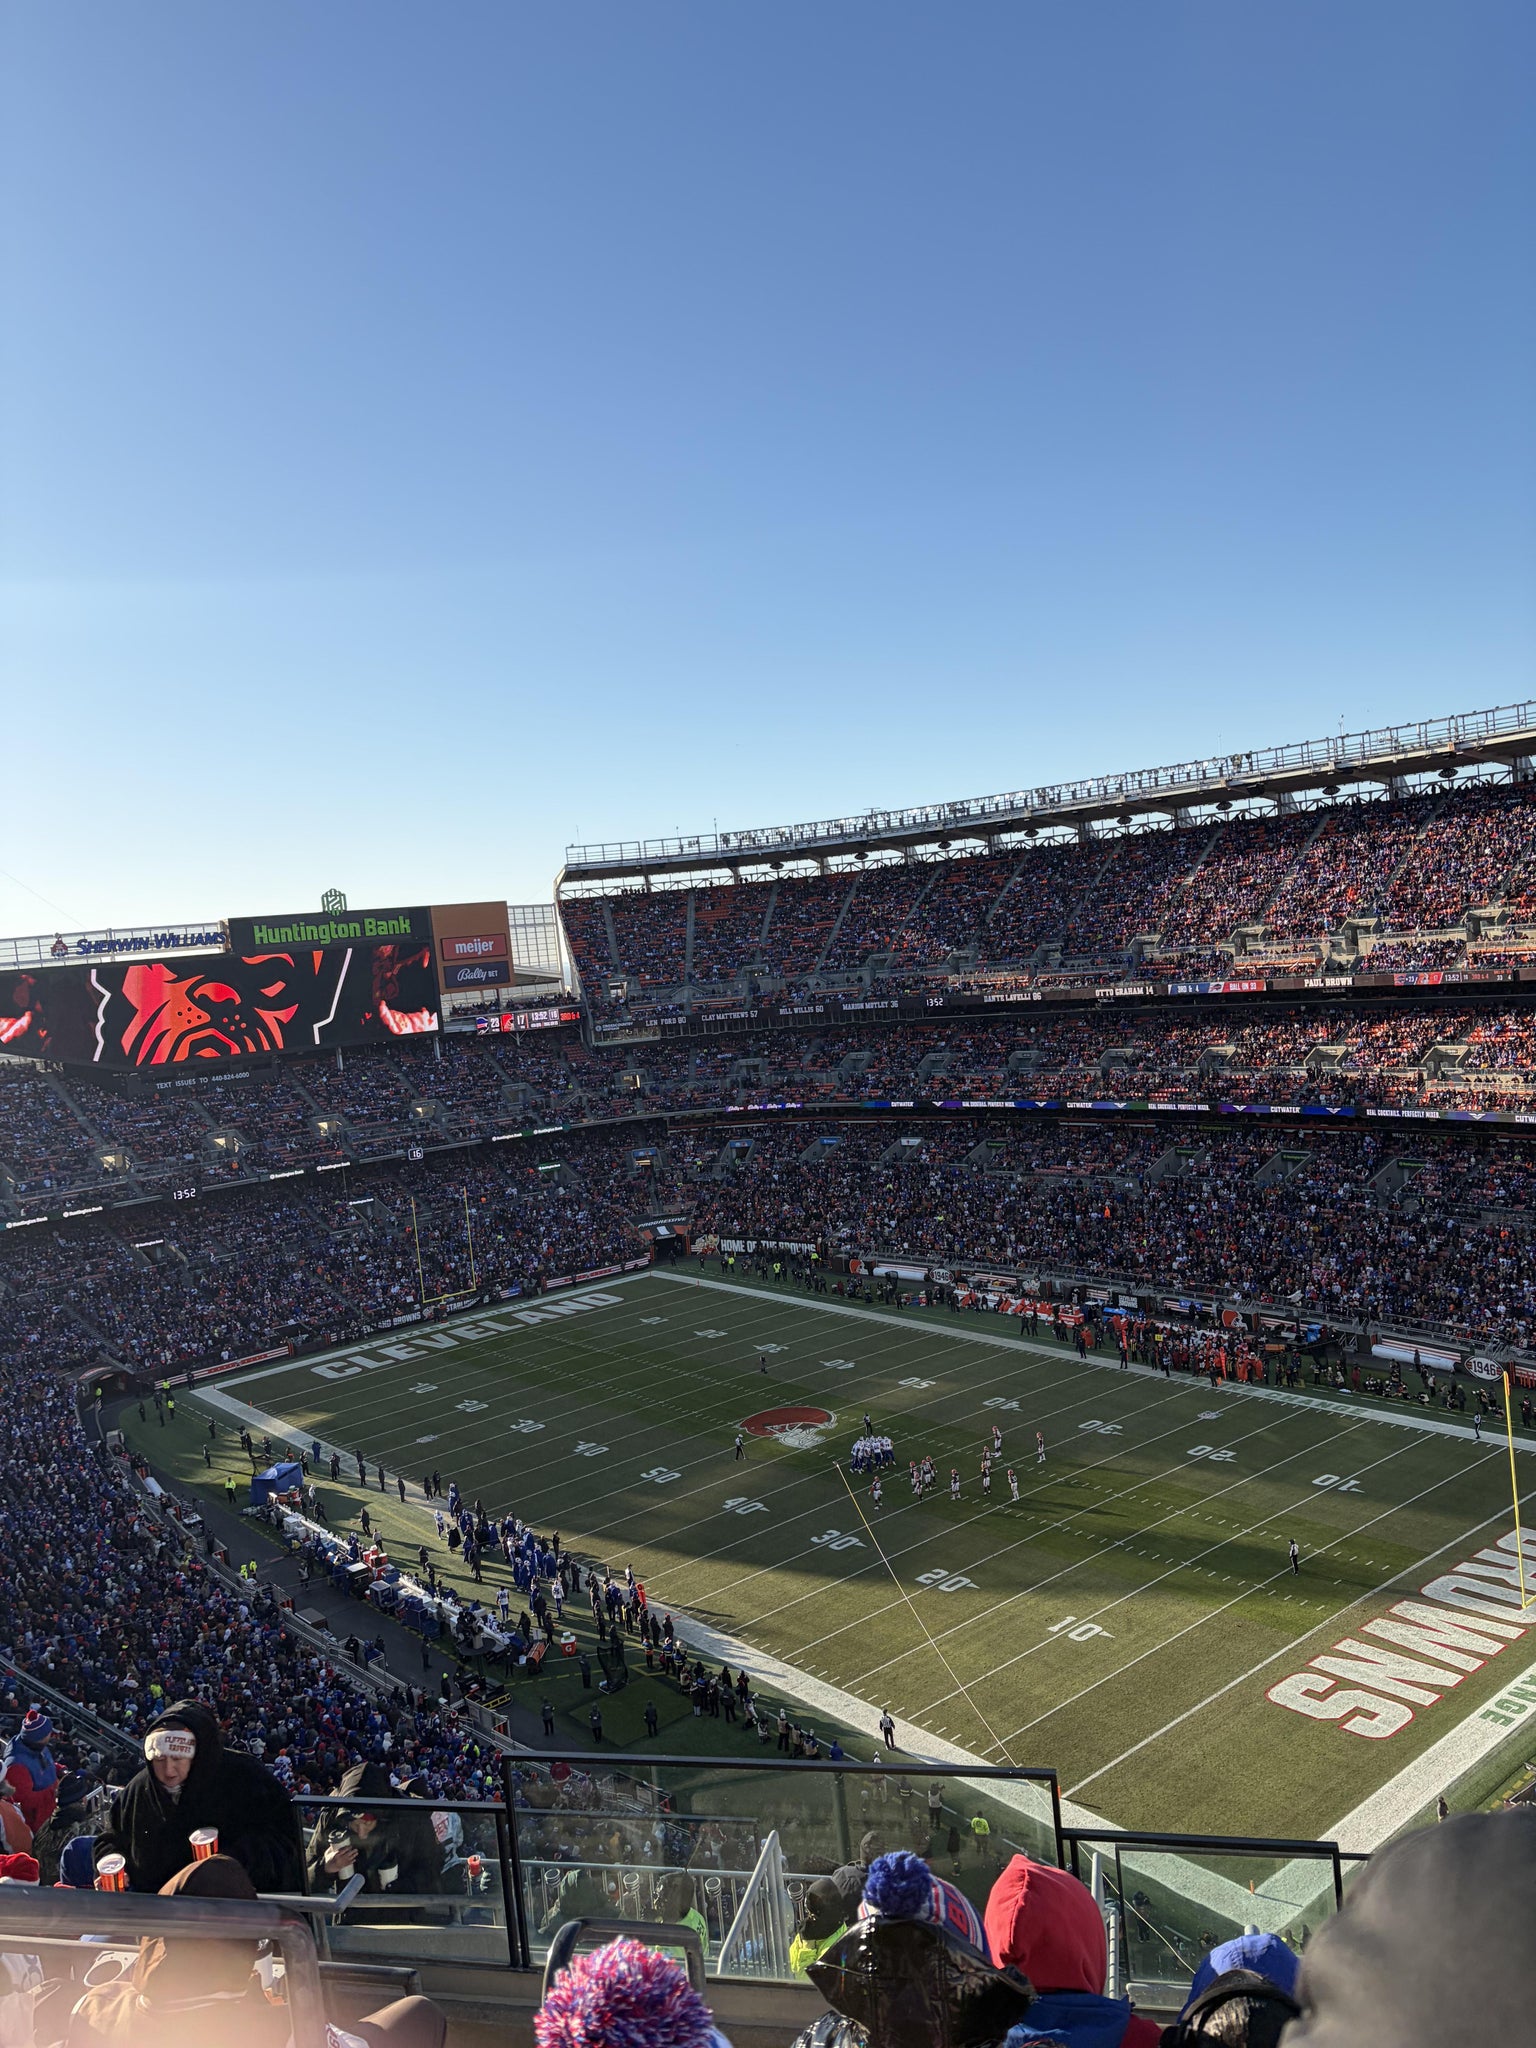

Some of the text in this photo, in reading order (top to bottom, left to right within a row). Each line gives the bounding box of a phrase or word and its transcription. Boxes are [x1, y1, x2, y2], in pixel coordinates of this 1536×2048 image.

[253, 916, 411, 944] Huntington Bank
[76, 932, 226, 955] SHERWIN-WILLIAMS
[455, 938, 494, 955] meijer
[457, 968, 487, 982] Bally
[1304, 977, 1352, 987] PAUL BROWN
[1005, 994, 1032, 1002] LAVELLI
[1095, 986, 1154, 997] OTTO GRAHAM 14
[794, 1006, 814, 1014] WILLIS
[865, 1001, 888, 1009] MOTLEY
[517, 1015, 525, 1025] 17
[531, 1011, 548, 1021] 13:52
[702, 1010, 758, 1021] CLAY MATTHEWS 57
[175, 1079, 196, 1087] ISSUES
[638, 1217, 687, 1228] PROGRESSIVE
[721, 1239, 745, 1252] HOME
[934, 1271, 948, 1280] 1946
[393, 1311, 421, 1326] BROWNS
[310, 1293, 624, 1379] CLEVELAND
[1473, 1360, 1496, 1376] 1946
[898, 1376, 937, 1389] 50
[1265, 1392, 1368, 1415] CHANGE
[510, 1420, 546, 1433] 30
[1078, 1420, 1122, 1433] 30
[573, 1442, 610, 1457] 40
[1186, 1445, 1236, 1461] 20
[640, 1466, 682, 1484] 50
[1312, 1474, 1360, 1492] 10
[724, 1496, 763, 1515] 40
[810, 1530, 858, 1551] 30
[915, 1568, 971, 1592] 20
[1047, 1616, 1103, 1642] 10
